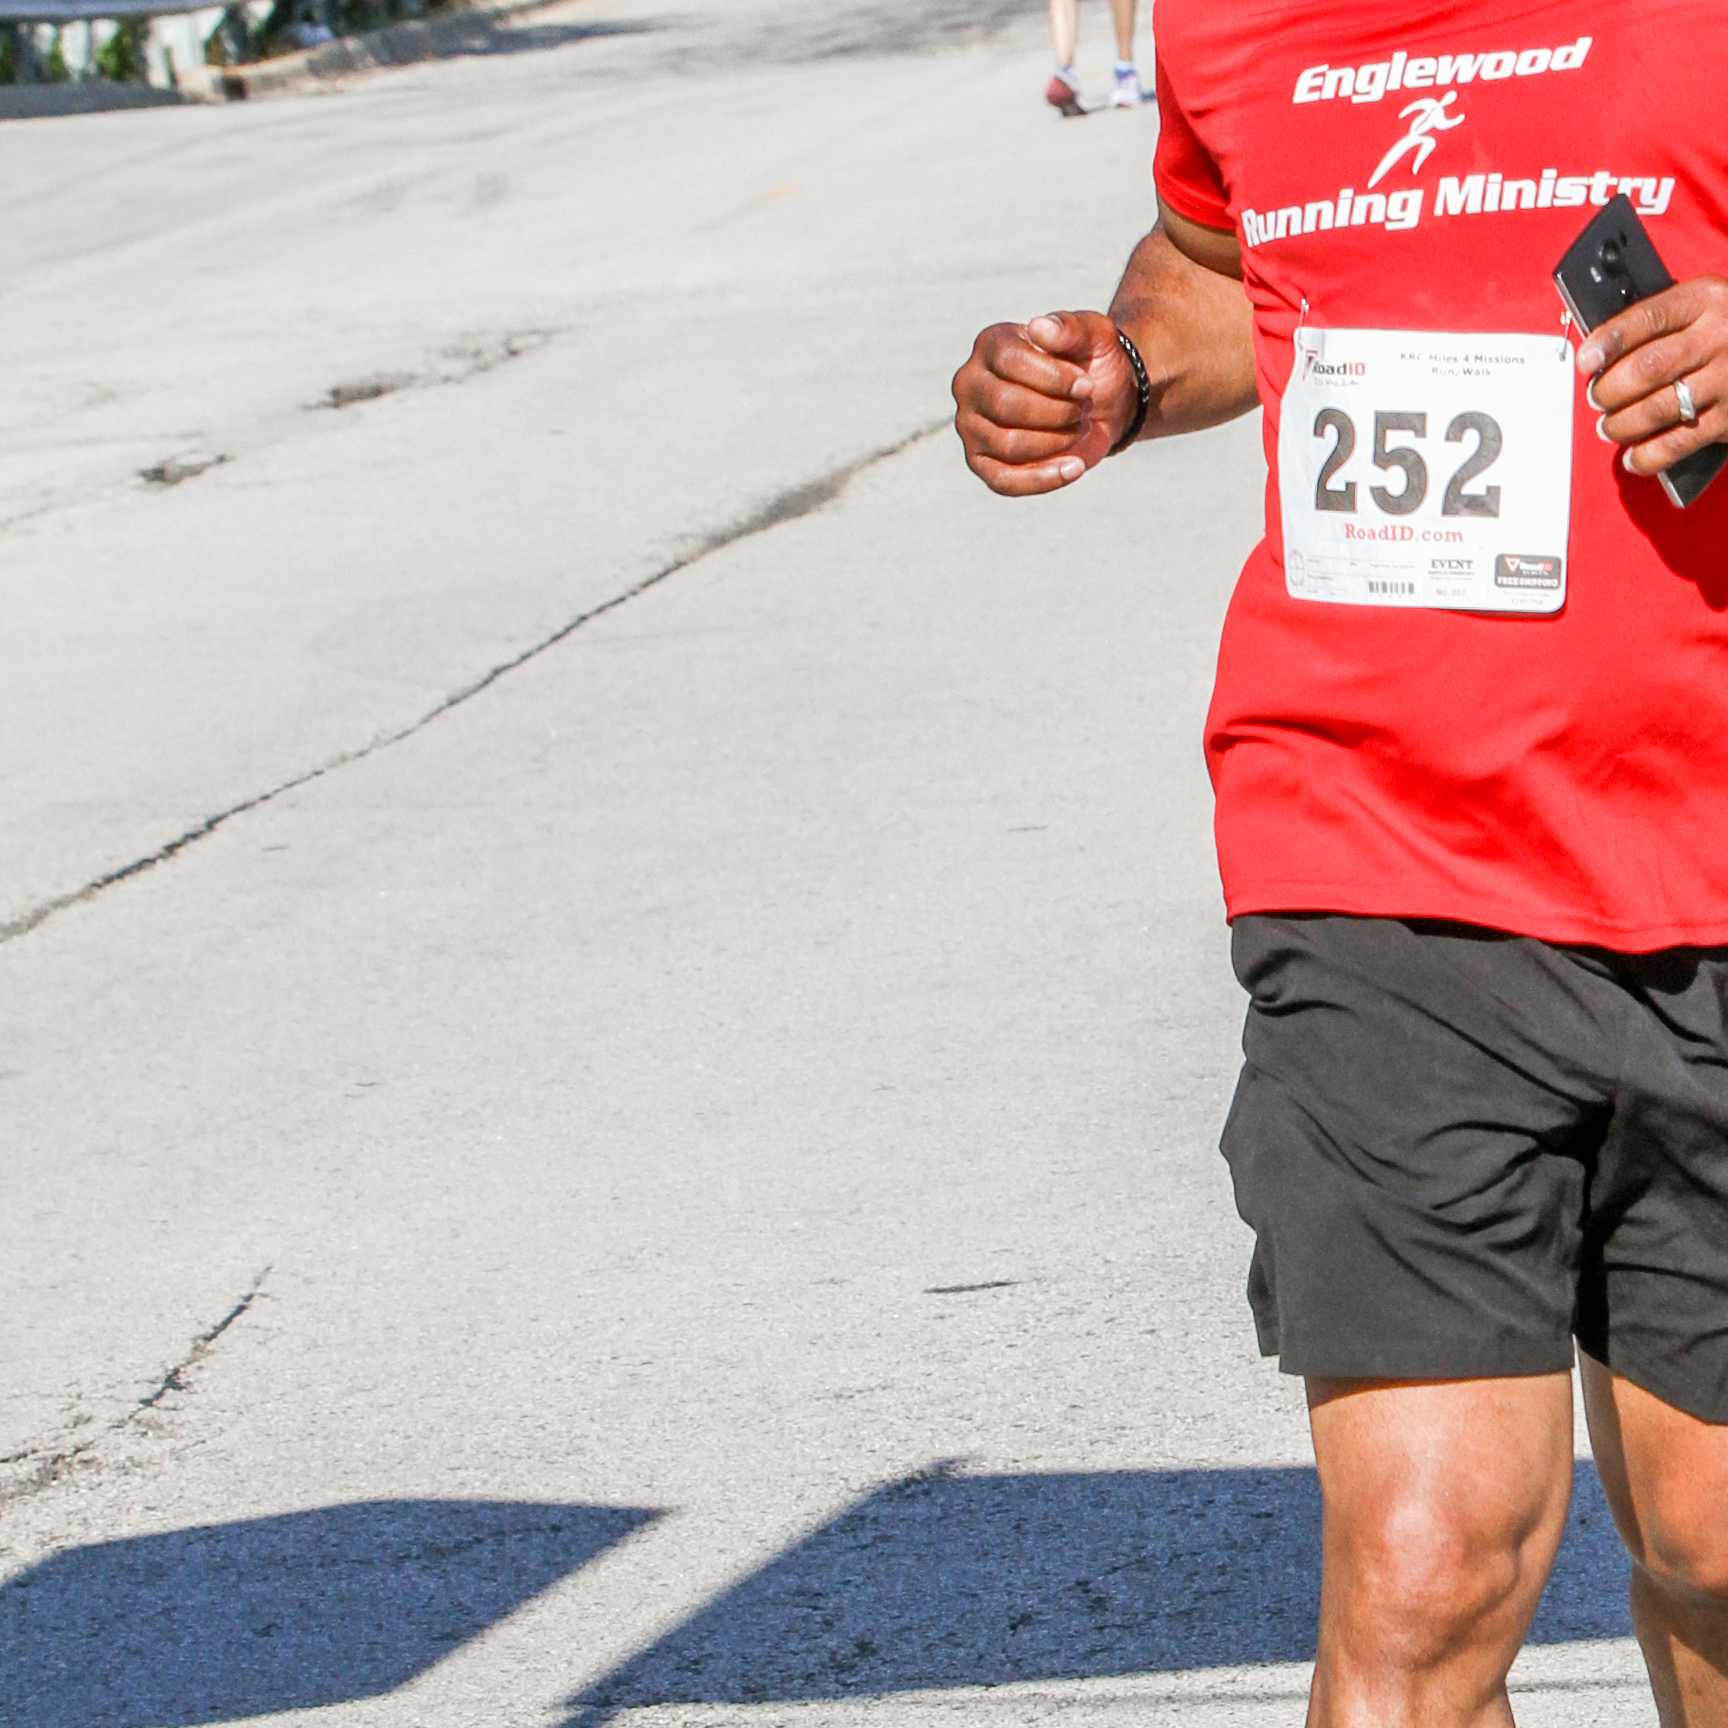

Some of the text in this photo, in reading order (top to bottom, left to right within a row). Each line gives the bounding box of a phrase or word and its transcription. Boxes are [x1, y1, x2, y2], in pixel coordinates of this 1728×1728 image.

[1292, 37, 1592, 103] Englewood
[1241, 169, 1675, 247] Running Ministry
[1428, 354, 1459, 363] Miles
[1474, 355, 1526, 365] Missions
[1312, 406, 1504, 518] 252
[1344, 523, 1465, 543] RoadID.com
[1430, 558, 1474, 569] EVENT
